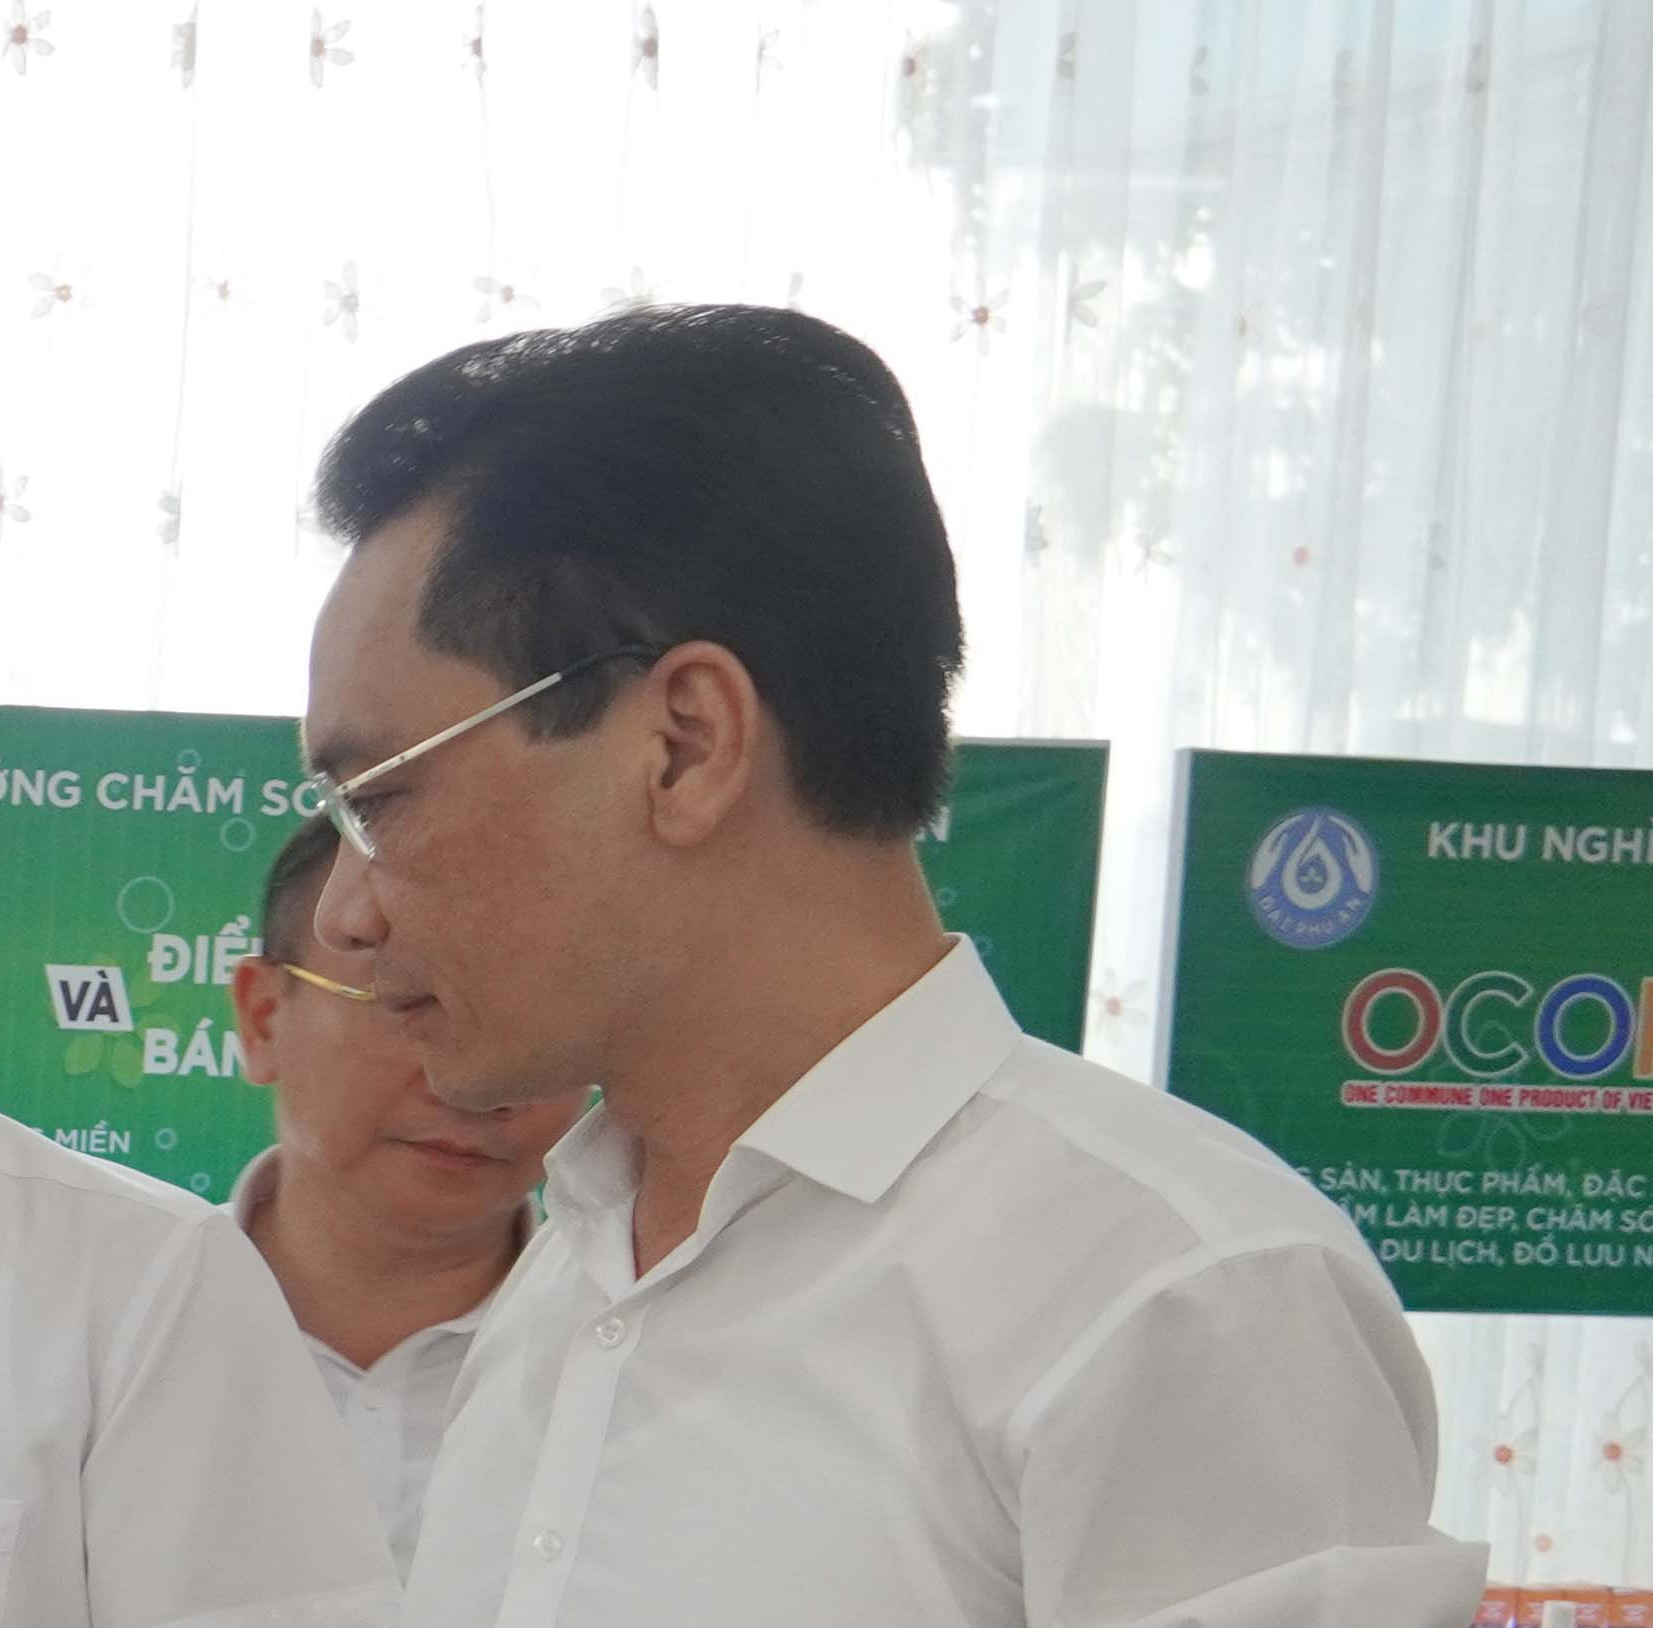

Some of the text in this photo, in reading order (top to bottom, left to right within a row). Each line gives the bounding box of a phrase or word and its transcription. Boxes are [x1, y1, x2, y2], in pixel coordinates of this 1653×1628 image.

[97, 766, 244, 815] CHĂM
[1428, 821, 1527, 860] KHU
[147, 915, 264, 985] ĐIỂ
[59, 969, 119, 1023] VÀ
